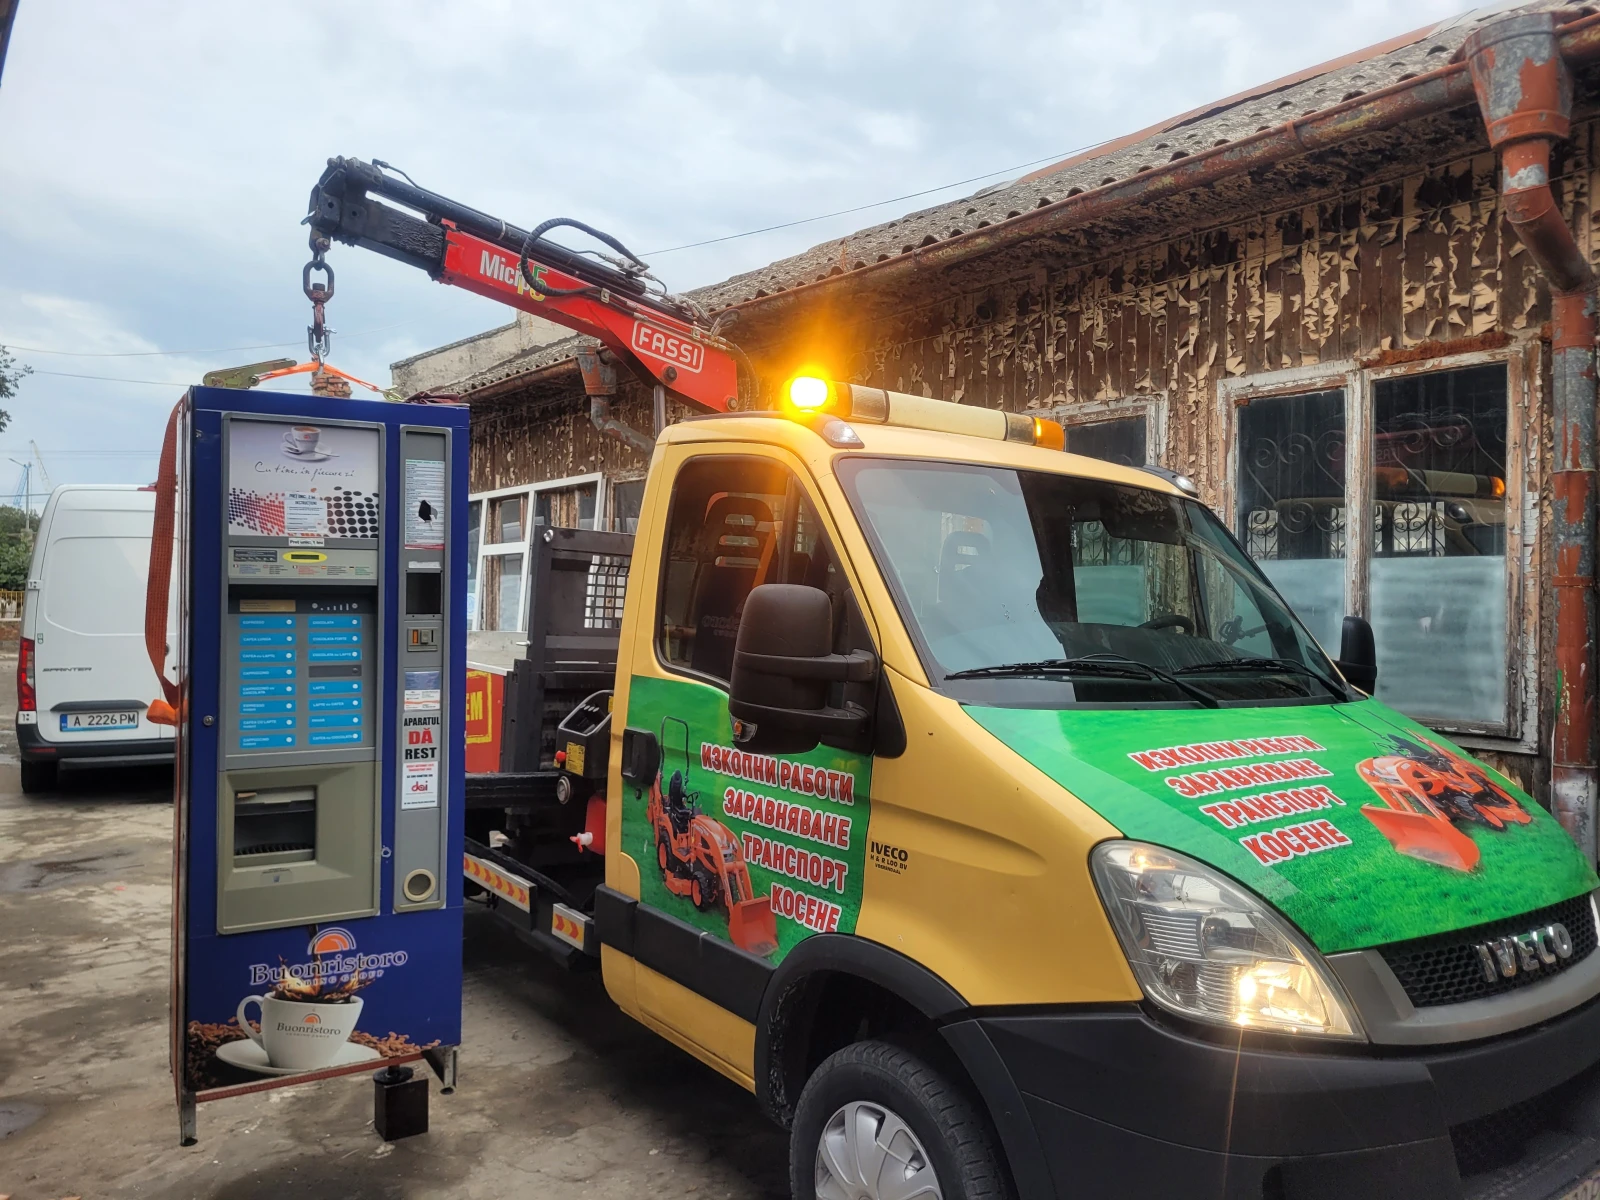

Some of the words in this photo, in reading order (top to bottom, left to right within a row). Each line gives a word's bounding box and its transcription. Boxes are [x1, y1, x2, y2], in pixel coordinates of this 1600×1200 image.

[638, 327, 699, 367] FASSI
[254, 461, 271, 473] Cu
[74, 715, 81, 727] A
[88, 714, 117, 726] 2226
[119, 714, 136, 725] PM
[404, 716, 440, 726] APARATUL
[408, 727, 433, 745] DĂ
[405, 747, 437, 760] REST
[1130, 741, 1251, 771] ИЗКОПНИ
[1238, 736, 1325, 757] РАБОТИ
[701, 743, 777, 785] ИЗКОПНИ
[780, 760, 854, 804] РАБОТИ
[1166, 759, 1332, 797] ЗАРАВНЯВАНЕ
[724, 788, 851, 848] ЗАРАВНЯВАНЕ
[1200, 786, 1345, 828] ТРАНСПОРТ
[870, 841, 909, 862] IVECO
[1241, 820, 1351, 865] КОСЕНЕ
[742, 832, 847, 892] ТРАНСПОРТ
[771, 883, 841, 932] КОСЕНЕ
[249, 951, 408, 986] Buonristoro
[1470, 922, 1573, 983] IVECO
[276, 1022, 341, 1036] Buonristoro
